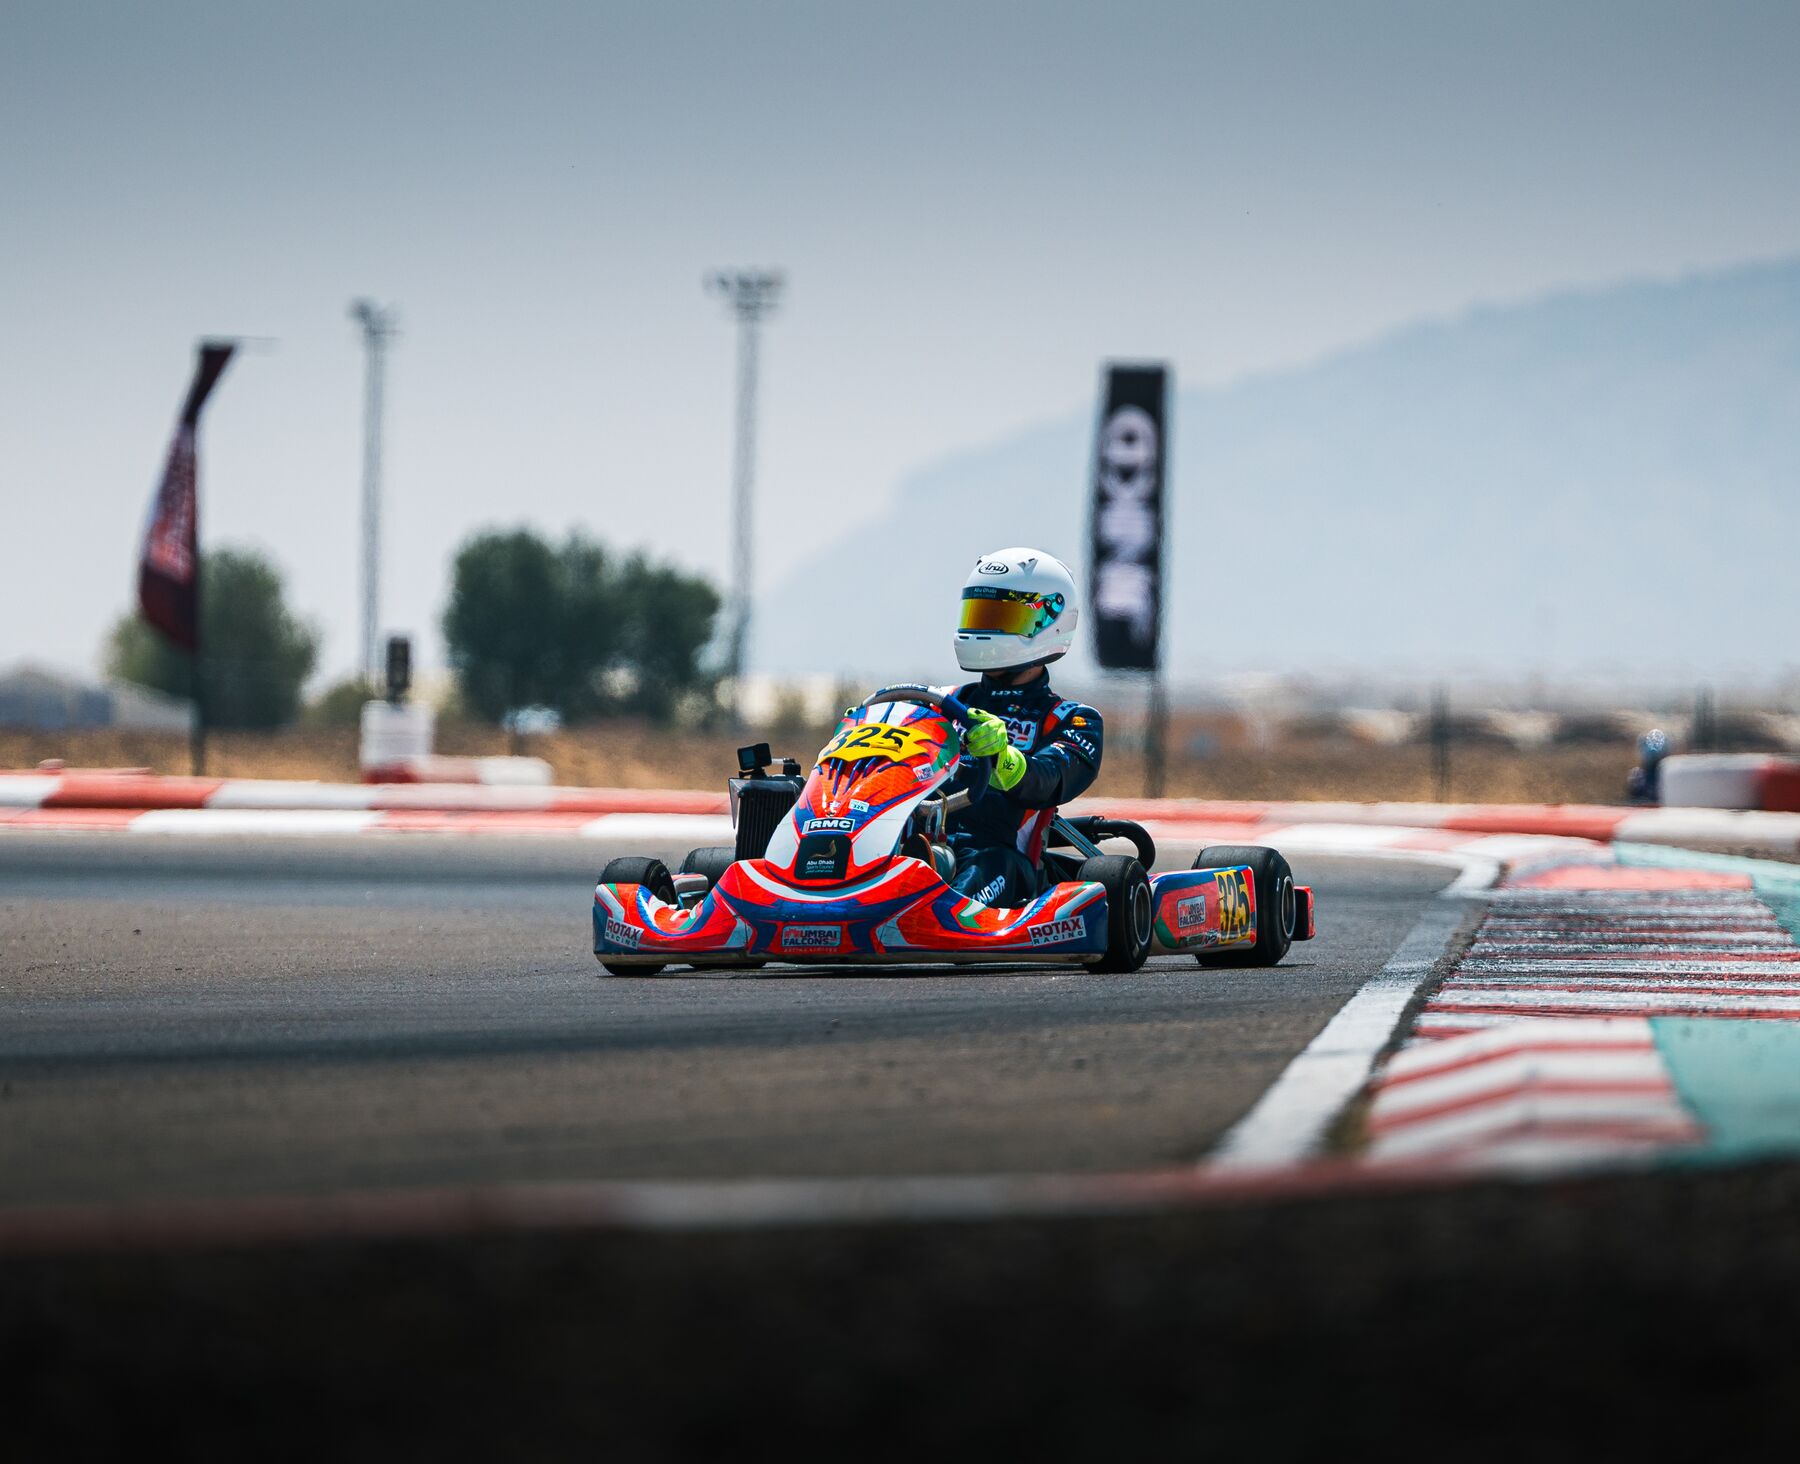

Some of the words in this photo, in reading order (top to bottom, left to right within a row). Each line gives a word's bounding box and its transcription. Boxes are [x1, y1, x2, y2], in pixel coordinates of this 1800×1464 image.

[823, 726, 911, 757] 325
[810, 819, 851, 829] RMC
[973, 875, 1006, 905] NORR
[1217, 872, 1250, 943] 325
[1030, 918, 1082, 938] ROTAX
[1180, 914, 1202, 926] FALCONS
[607, 919, 641, 941] ROTAX
[1033, 930, 1084, 945] RACING
[605, 932, 637, 947] RACING
[784, 937, 829, 945] FALCONS
